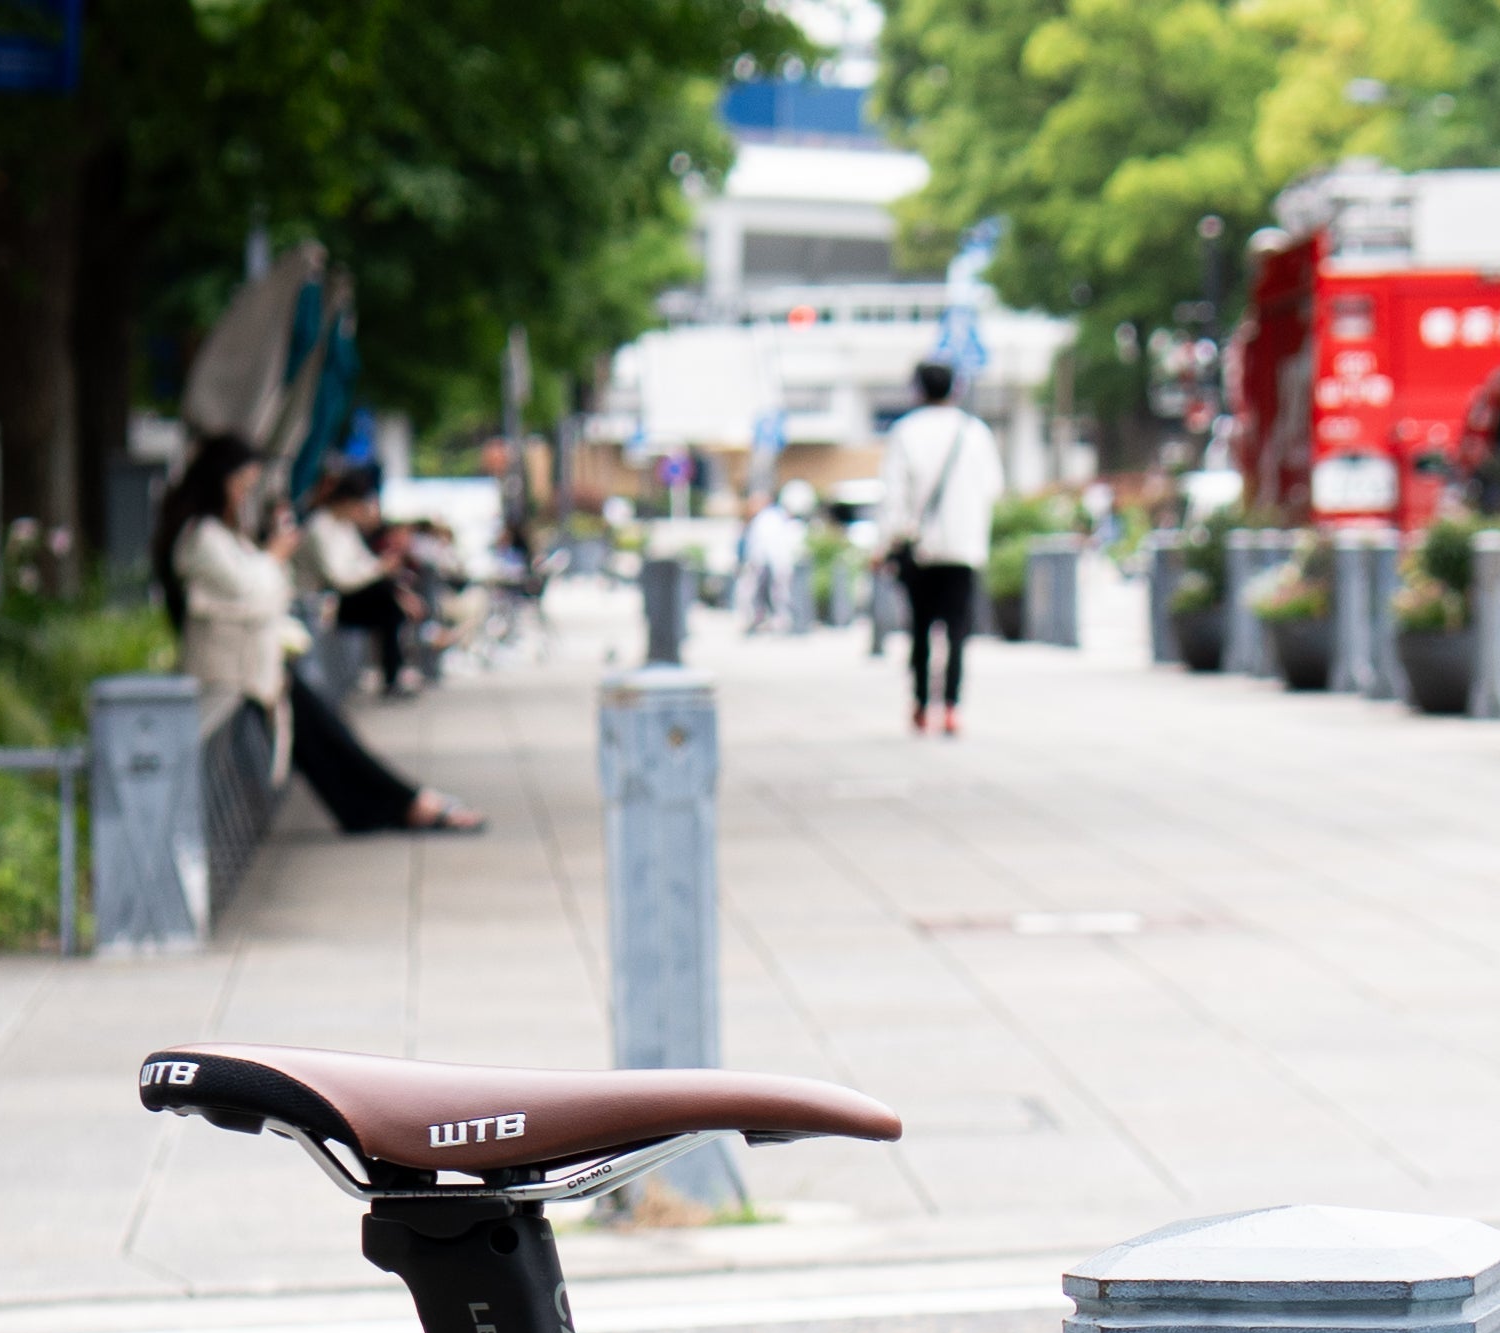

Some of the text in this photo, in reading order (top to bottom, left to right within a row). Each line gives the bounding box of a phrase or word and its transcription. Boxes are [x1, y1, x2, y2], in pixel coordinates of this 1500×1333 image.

[141, 1061, 200, 1087] WTB
[429, 1112, 526, 1148] WTB
[566, 1163, 613, 1190] CR-MO
